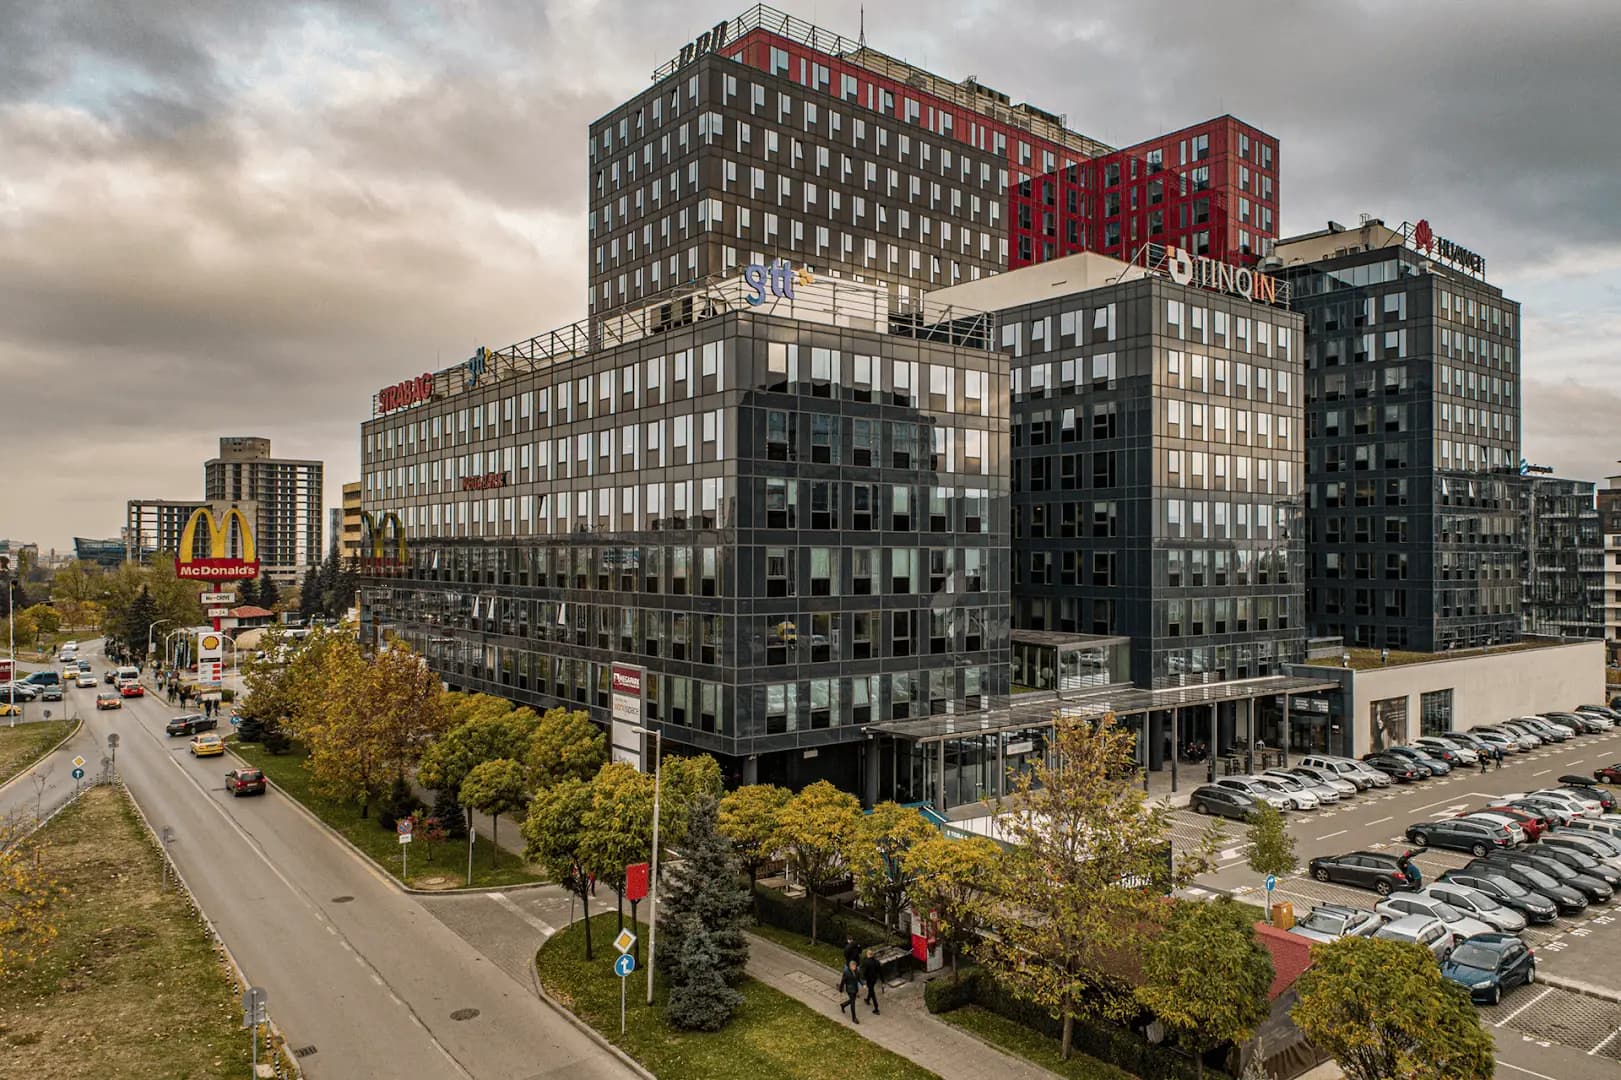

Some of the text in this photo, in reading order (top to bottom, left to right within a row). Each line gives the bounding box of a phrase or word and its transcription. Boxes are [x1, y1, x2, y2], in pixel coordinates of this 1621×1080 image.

[745, 258, 795, 306] gtt
[1198, 256, 1276, 303] TINQIN
[379, 373, 432, 412] STRABAG
[180, 565, 256, 576] McDonald's
